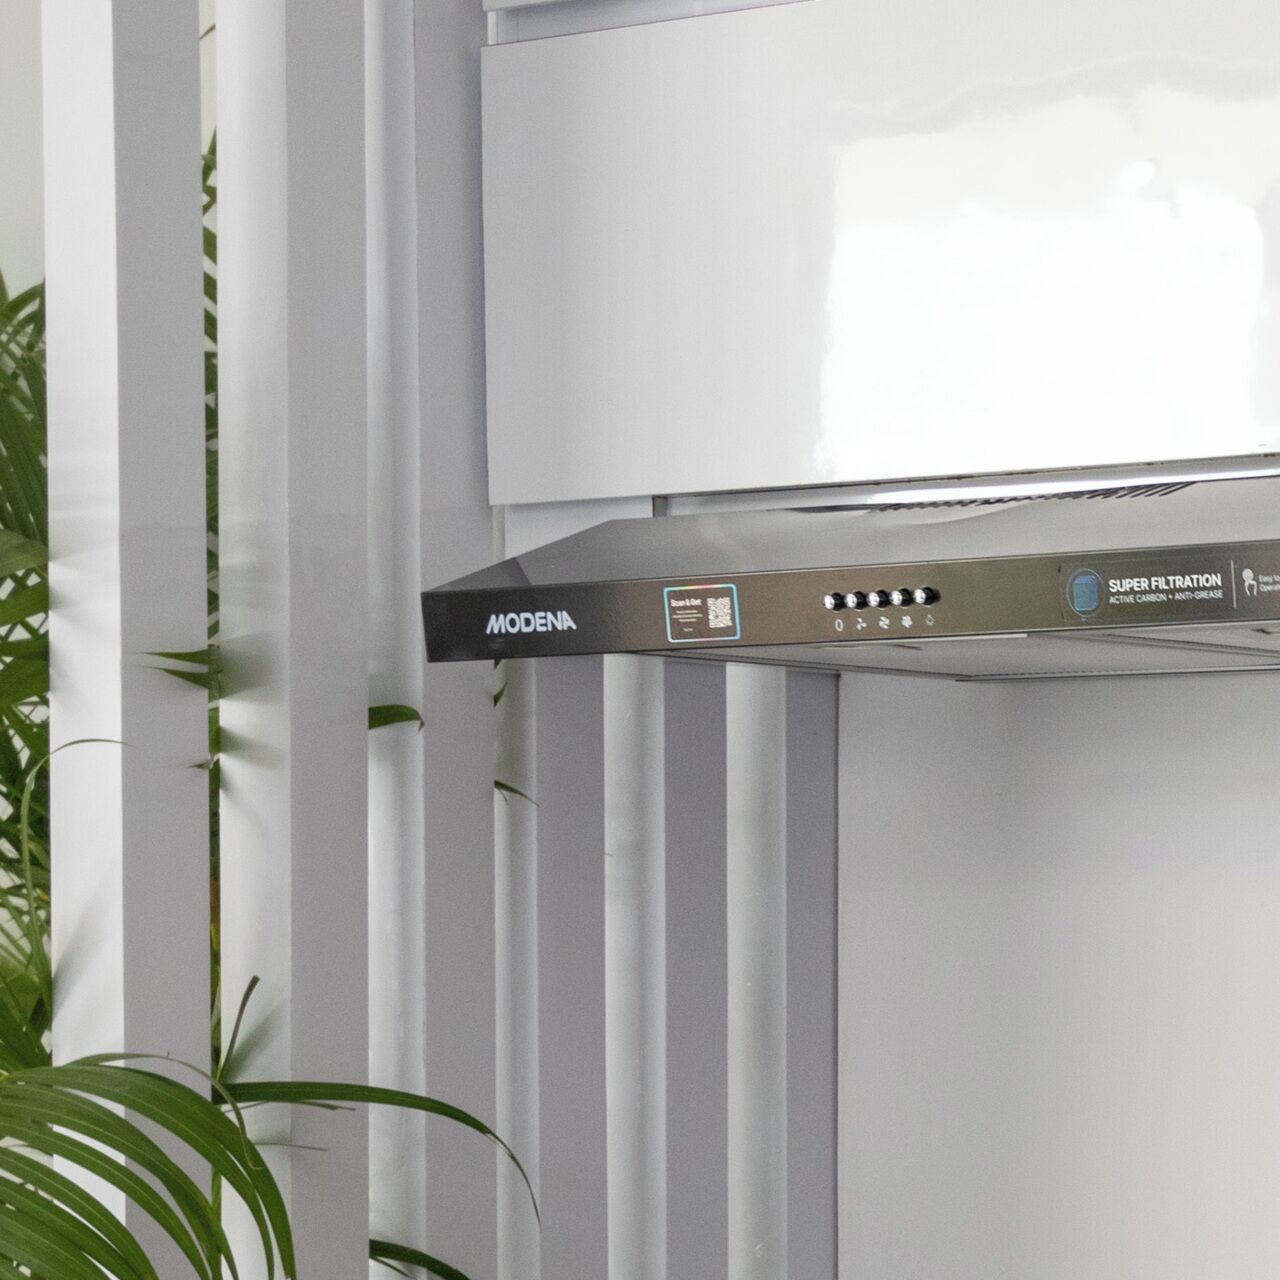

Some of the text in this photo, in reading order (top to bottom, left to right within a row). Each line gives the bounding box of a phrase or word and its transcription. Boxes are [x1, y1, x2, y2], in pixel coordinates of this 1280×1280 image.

[1108, 573, 1222, 592] SUPER FILTRATION
[1109, 594, 1135, 604] ACTIVE
[1135, 592, 1167, 603] CARBON
[1174, 589, 1224, 601] ANTI-GREASE
[486, 610, 577, 635] MODENA
